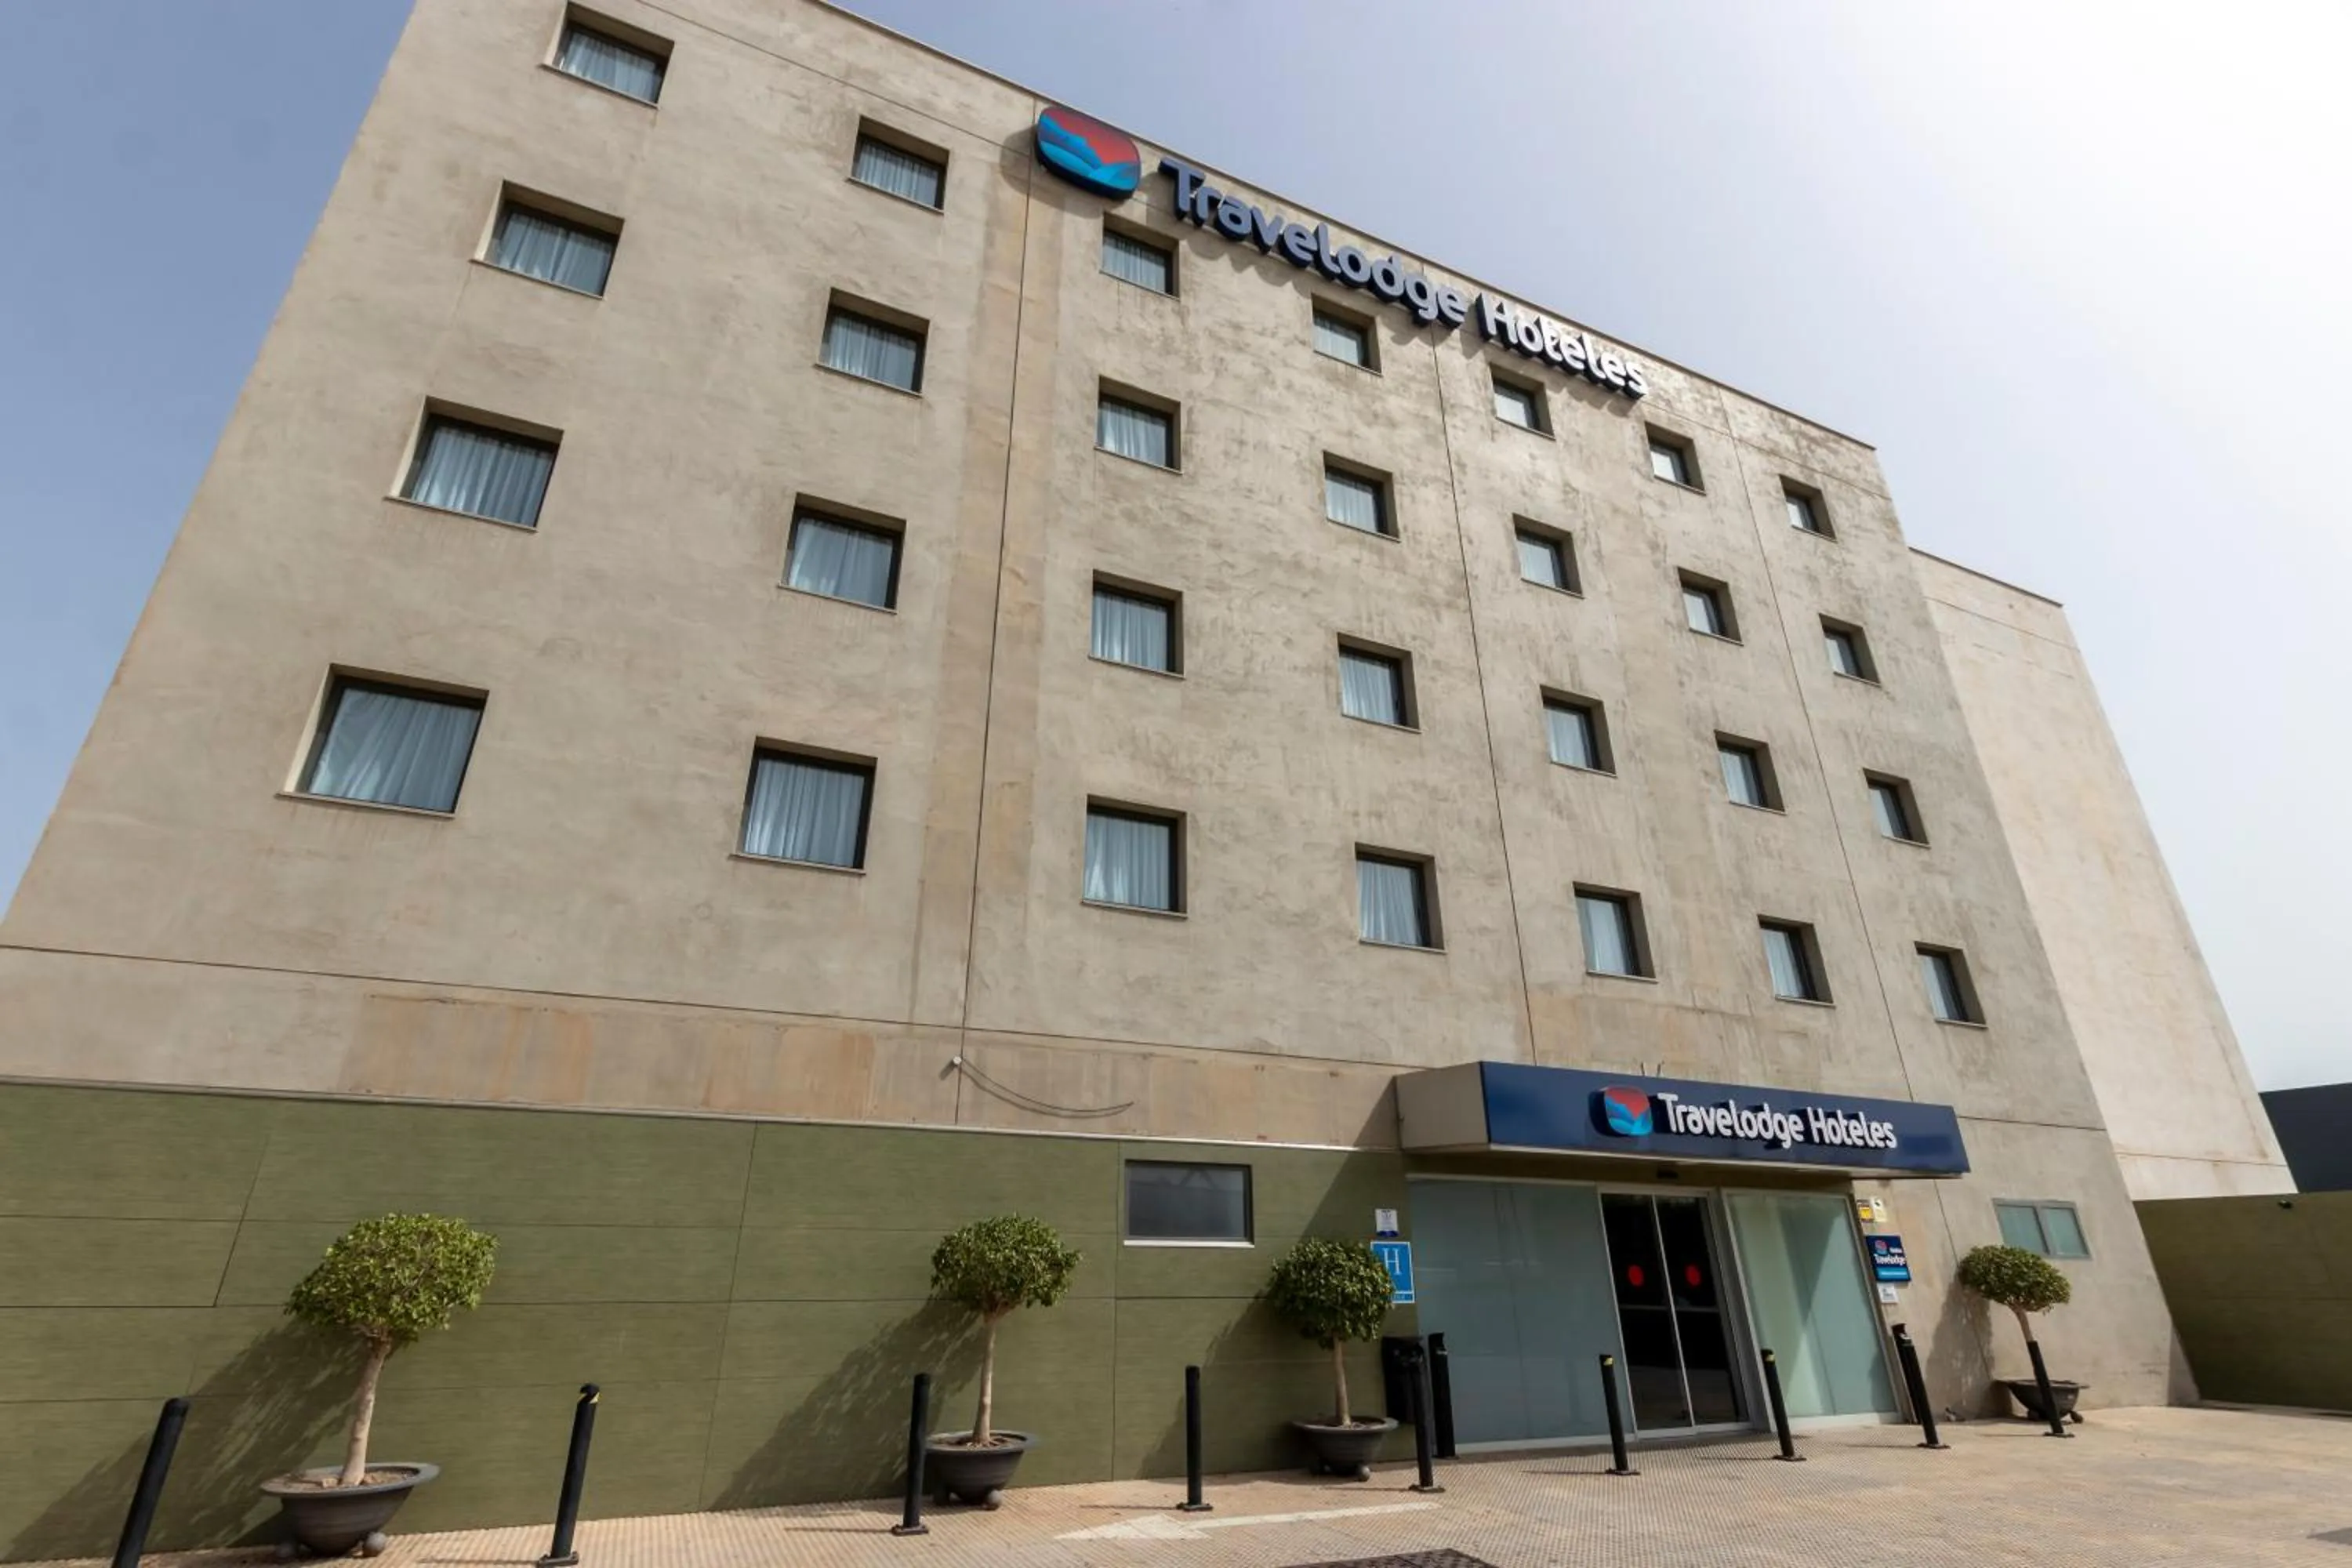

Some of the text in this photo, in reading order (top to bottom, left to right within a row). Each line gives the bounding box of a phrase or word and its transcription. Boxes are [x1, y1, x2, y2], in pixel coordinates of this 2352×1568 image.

[1158, 157, 1650, 400] Travelodge Hoteles
[1657, 1092, 1897, 1149] Travelodge Hoteles
[1382, 1247, 1402, 1276] H
